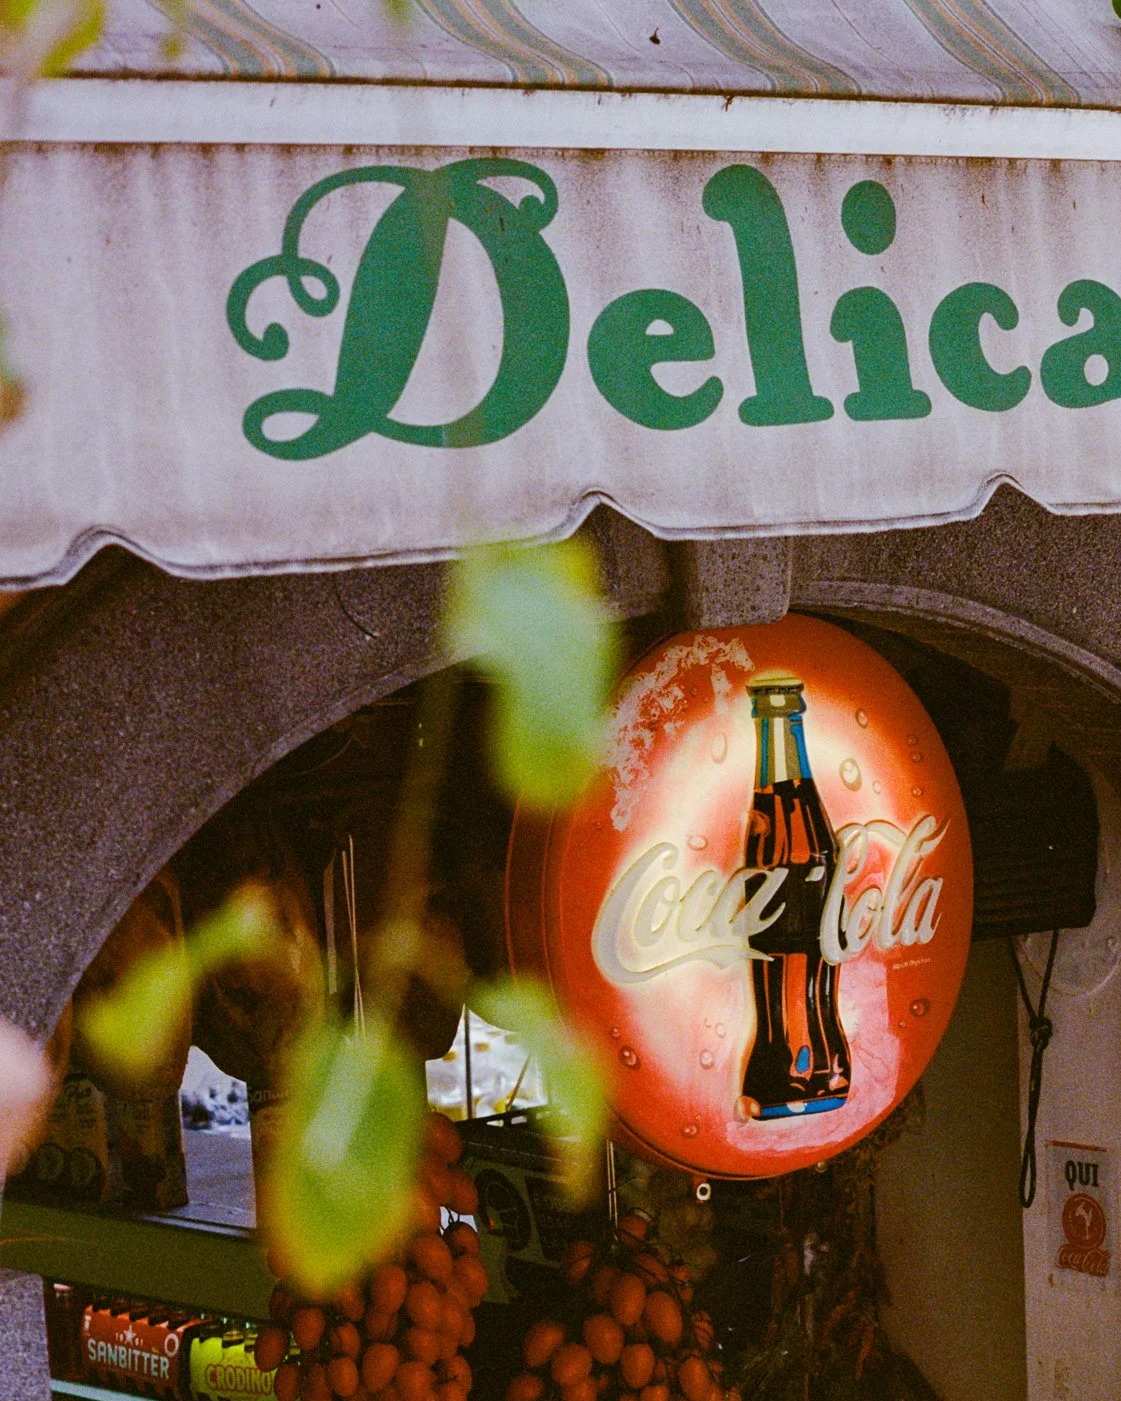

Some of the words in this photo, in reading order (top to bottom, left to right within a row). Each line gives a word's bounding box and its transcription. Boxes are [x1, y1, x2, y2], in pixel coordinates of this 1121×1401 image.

[1065, 1160, 1099, 1190] QUI
[87, 1338, 170, 1380] SANBITTER
[205, 1364, 272, 1396] CRODINO
